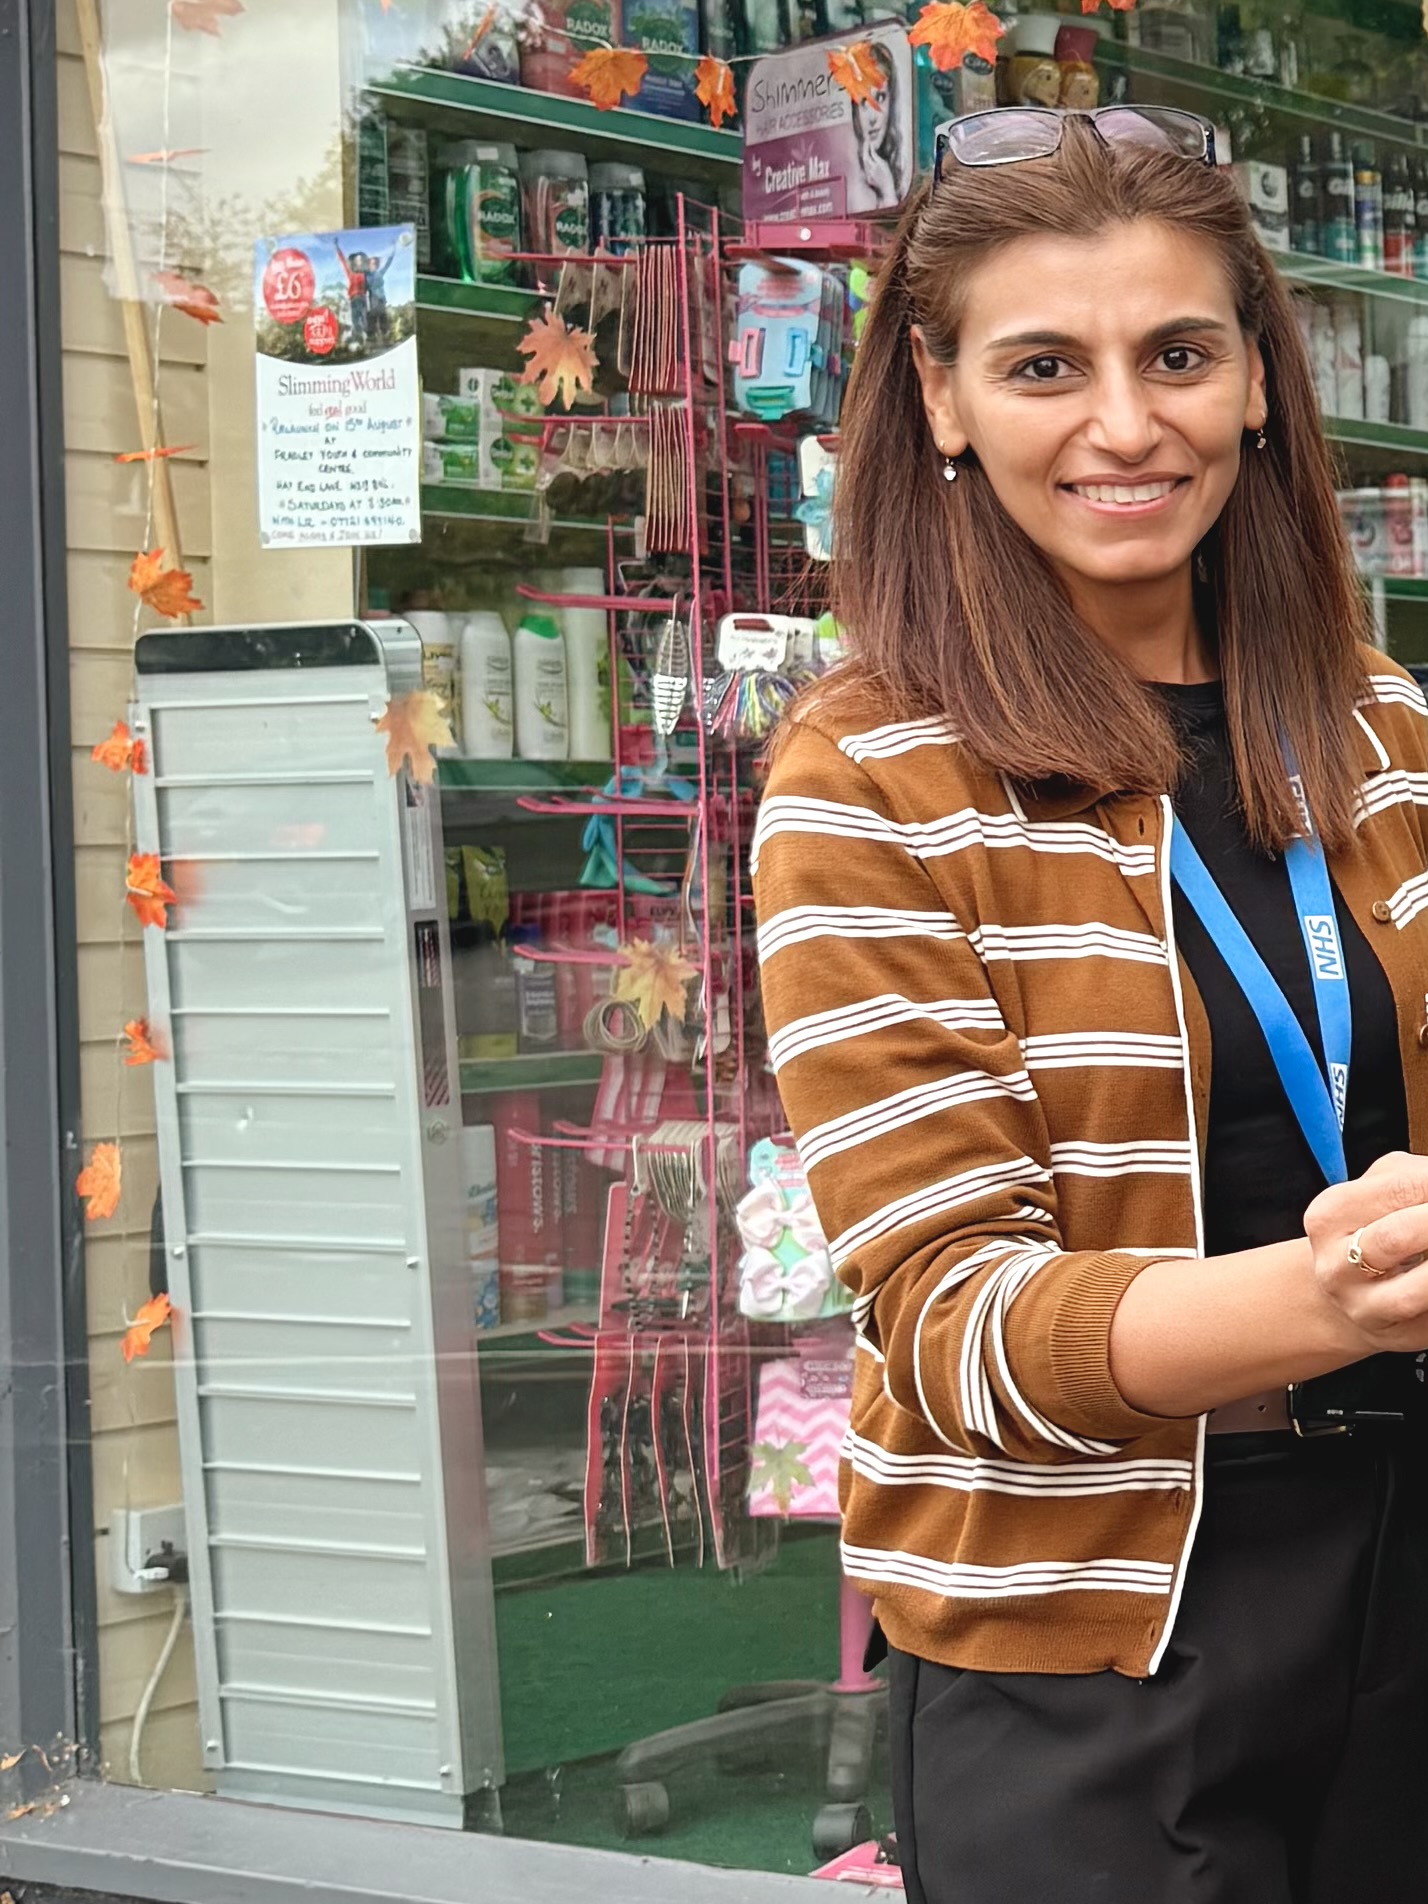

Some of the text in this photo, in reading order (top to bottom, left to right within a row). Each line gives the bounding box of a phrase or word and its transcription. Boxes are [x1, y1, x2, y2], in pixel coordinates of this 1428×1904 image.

[566, 17, 608, 36] RADOX
[752, 71, 847, 113] Shimmer
[765, 159, 806, 194] Creative
[808, 156, 831, 182] Max
[1308, 919, 1340, 976] NHS
